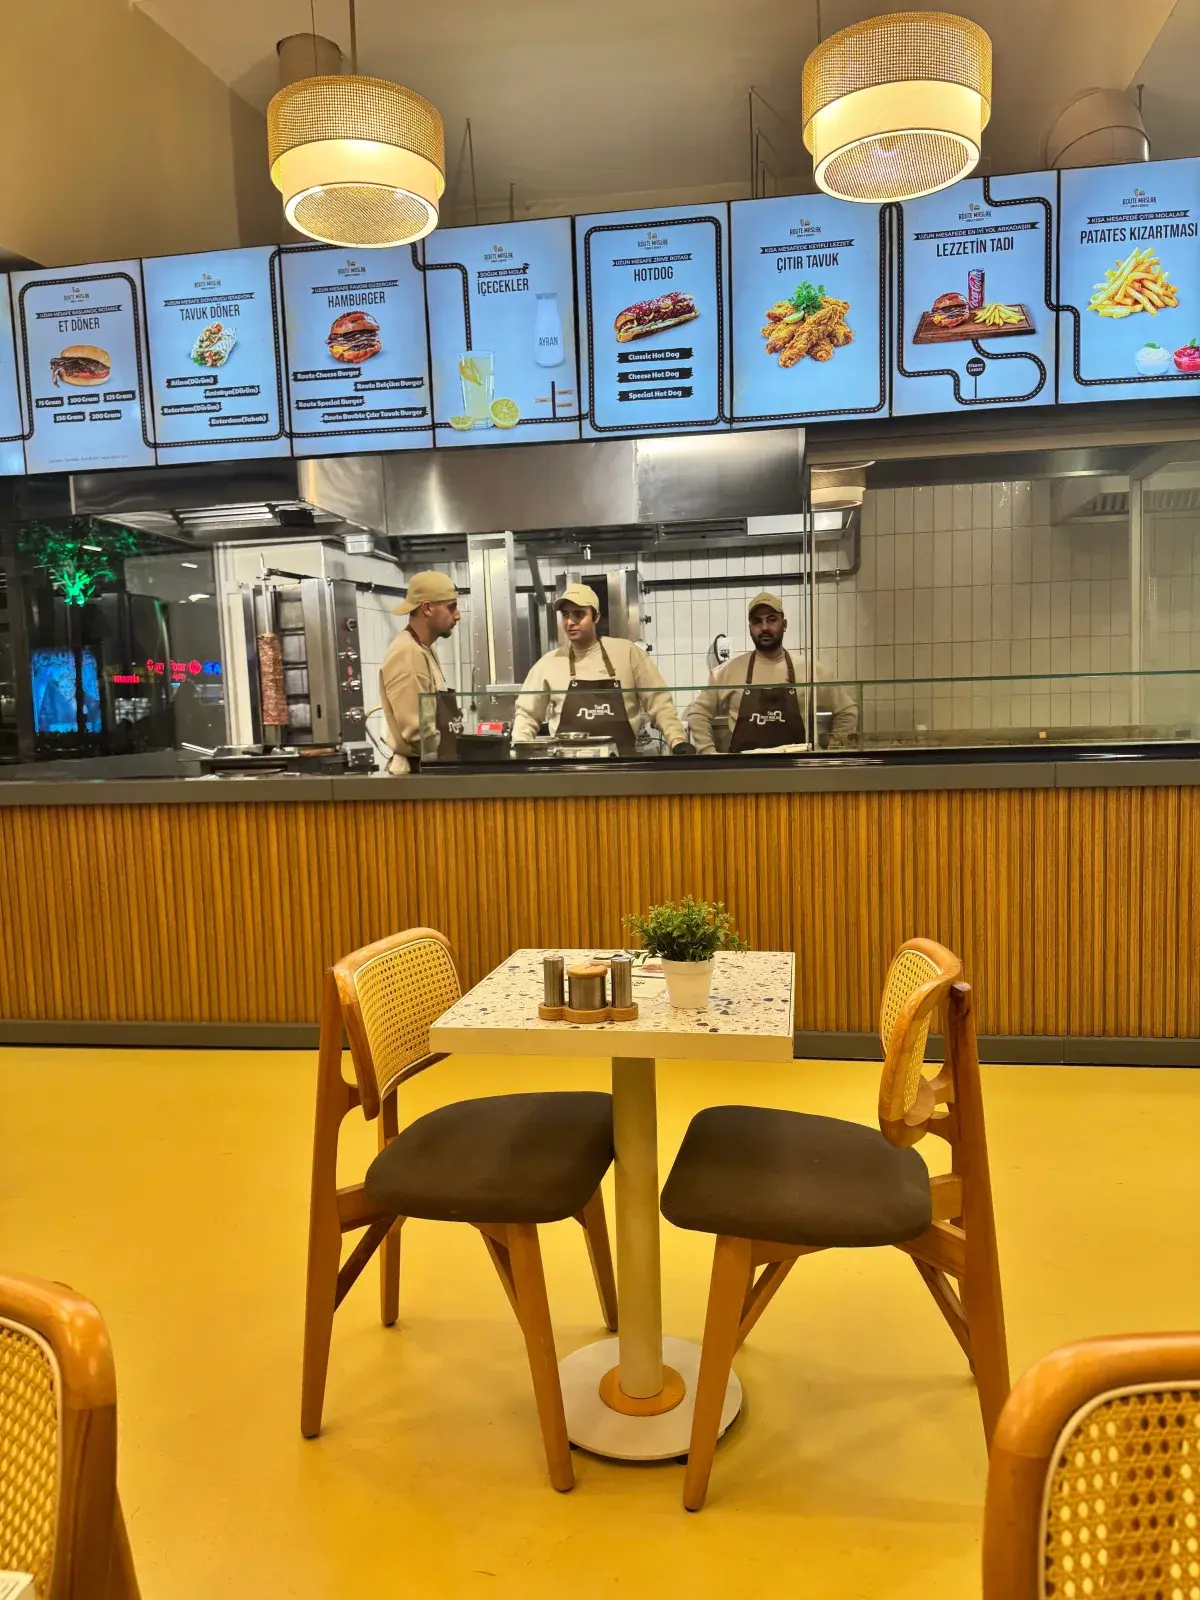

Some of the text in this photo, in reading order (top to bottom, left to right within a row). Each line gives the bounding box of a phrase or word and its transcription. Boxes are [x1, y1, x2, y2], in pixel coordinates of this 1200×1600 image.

[1122, 198, 1137, 206] ROUTE
[959, 212, 973, 220] ROUTE
[790, 228, 803, 236] ROUTE
[997, 224, 1031, 232] ARKADAŞIN
[1081, 223, 1198, 245] PATATES KIZARTMASI
[936, 237, 1014, 257] LEZZETİN TADI
[777, 253, 839, 273] ÇITIR TAVUK
[634, 266, 673, 282] HOTDOG
[477, 278, 529, 297] İÇECEKLER
[328, 291, 386, 308] HAMBURGER
[179, 304, 240, 320] TAVUK DÖNER
[59, 317, 100, 332] ET DÖNER
[539, 337, 559, 346] AYRAN
[337, 370, 359, 378] Burger
[400, 380, 422, 388] Burger
